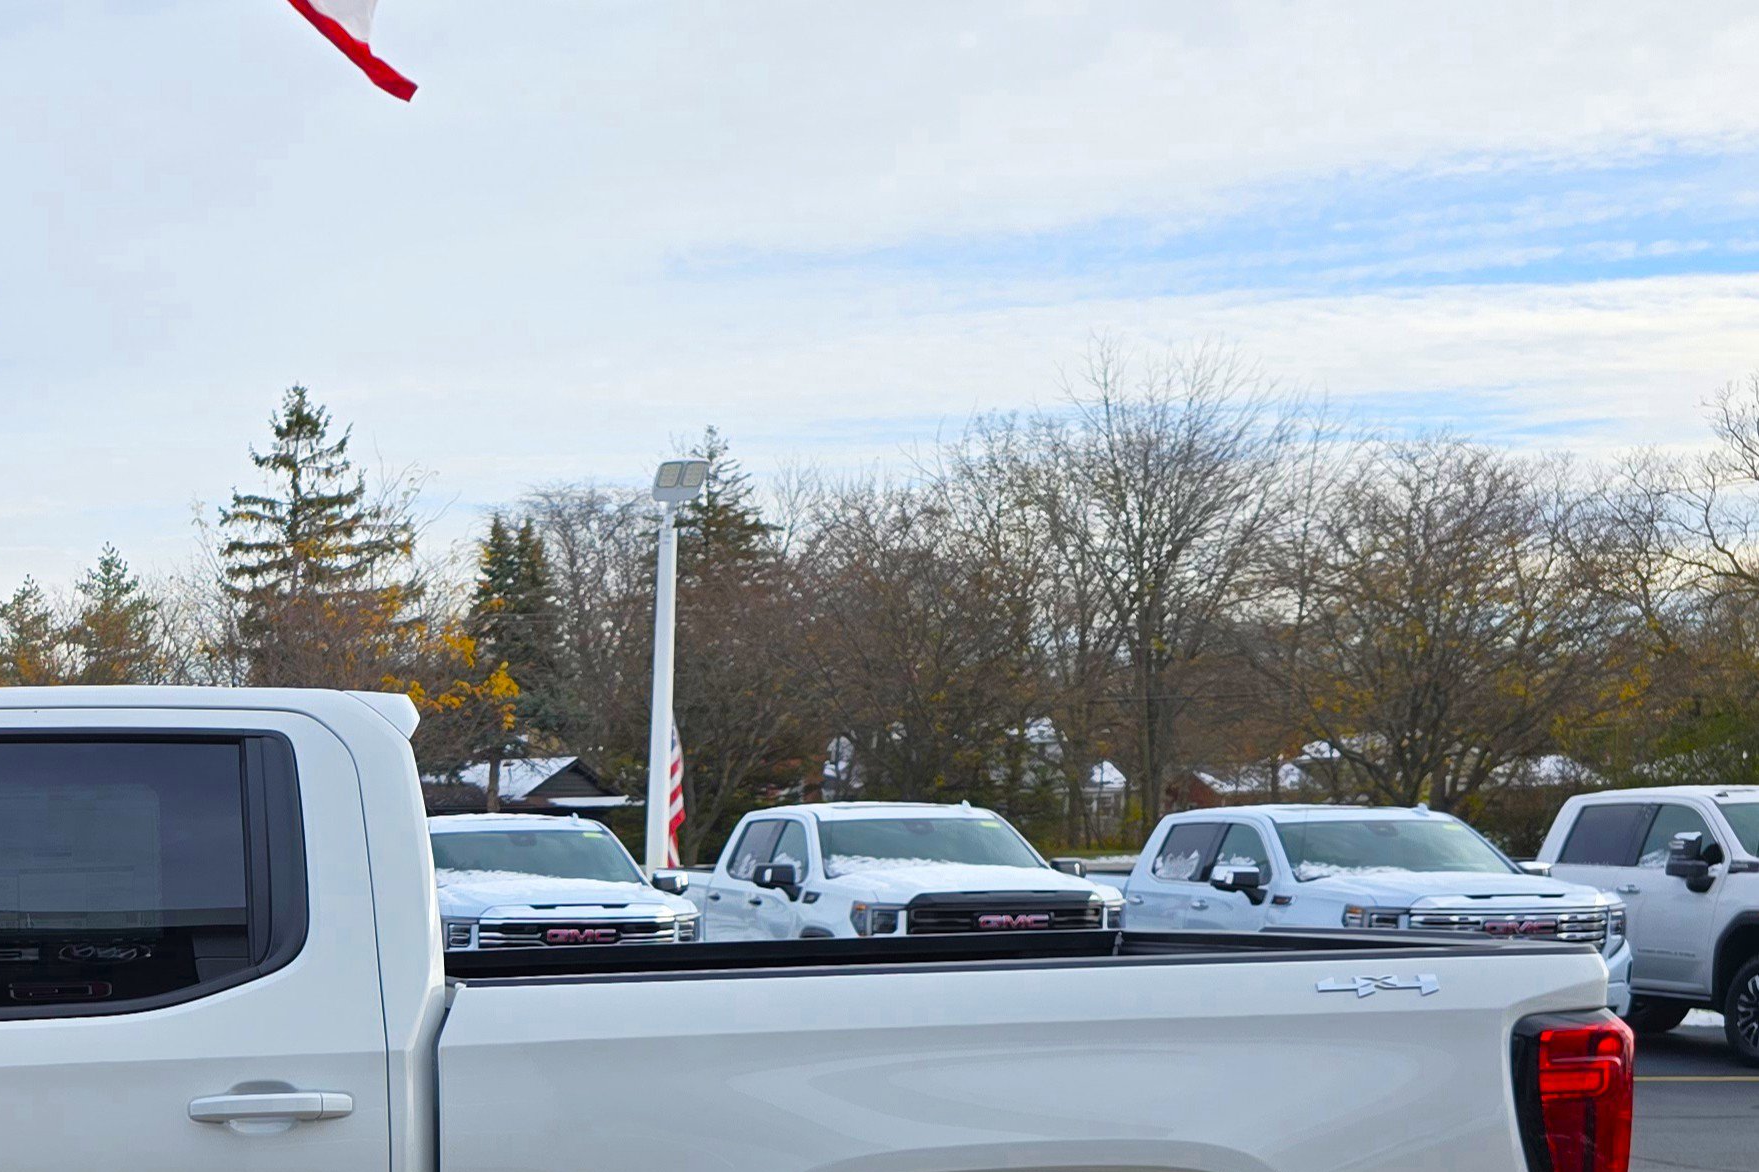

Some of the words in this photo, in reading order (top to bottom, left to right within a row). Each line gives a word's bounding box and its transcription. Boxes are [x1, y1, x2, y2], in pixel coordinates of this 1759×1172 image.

[978, 914, 1050, 929] GMC
[1484, 921, 1557, 935] GMC
[546, 928, 617, 943] GMC
